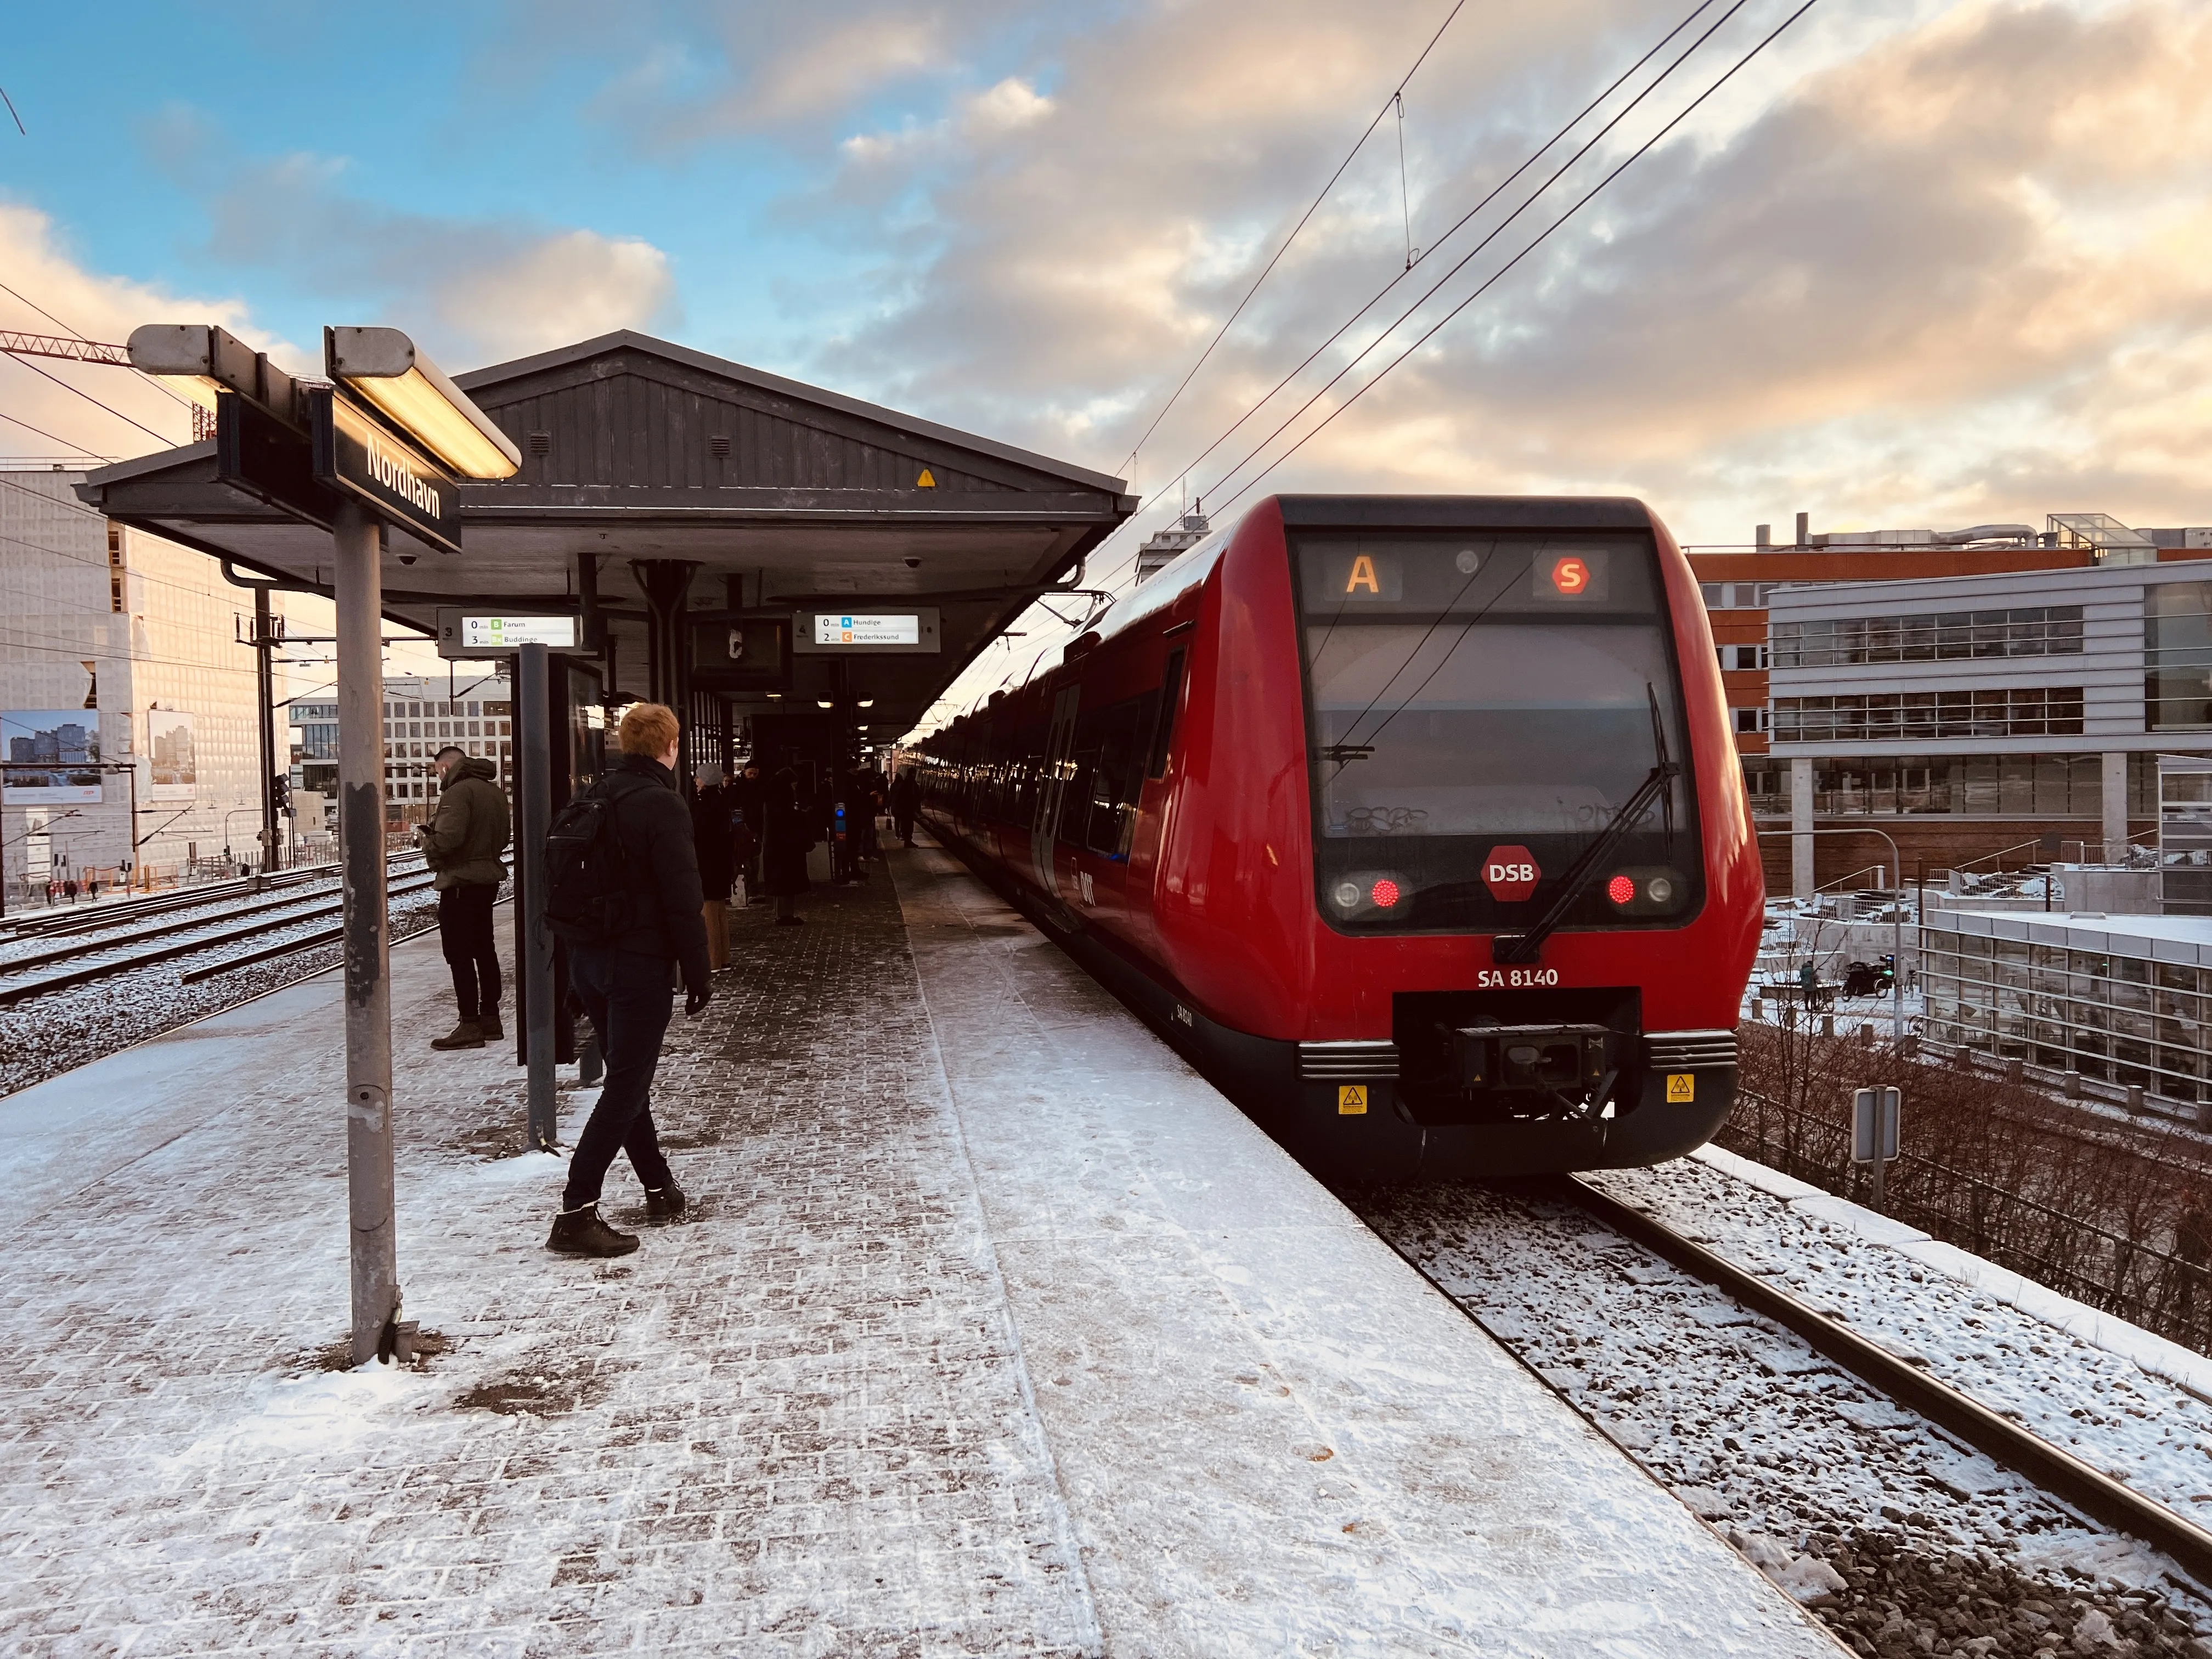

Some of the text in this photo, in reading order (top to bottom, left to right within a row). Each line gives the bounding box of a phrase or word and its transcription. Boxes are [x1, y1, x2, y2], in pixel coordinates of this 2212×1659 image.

[366, 432, 440, 520] Nordhavn
[1346, 556, 1379, 593] A
[1561, 564, 1581, 587] S
[472, 636, 478, 644] 3
[1489, 864, 1534, 883] DSB
[1080, 871, 1096, 907] DOT
[1478, 968, 1559, 988] SA 8140
